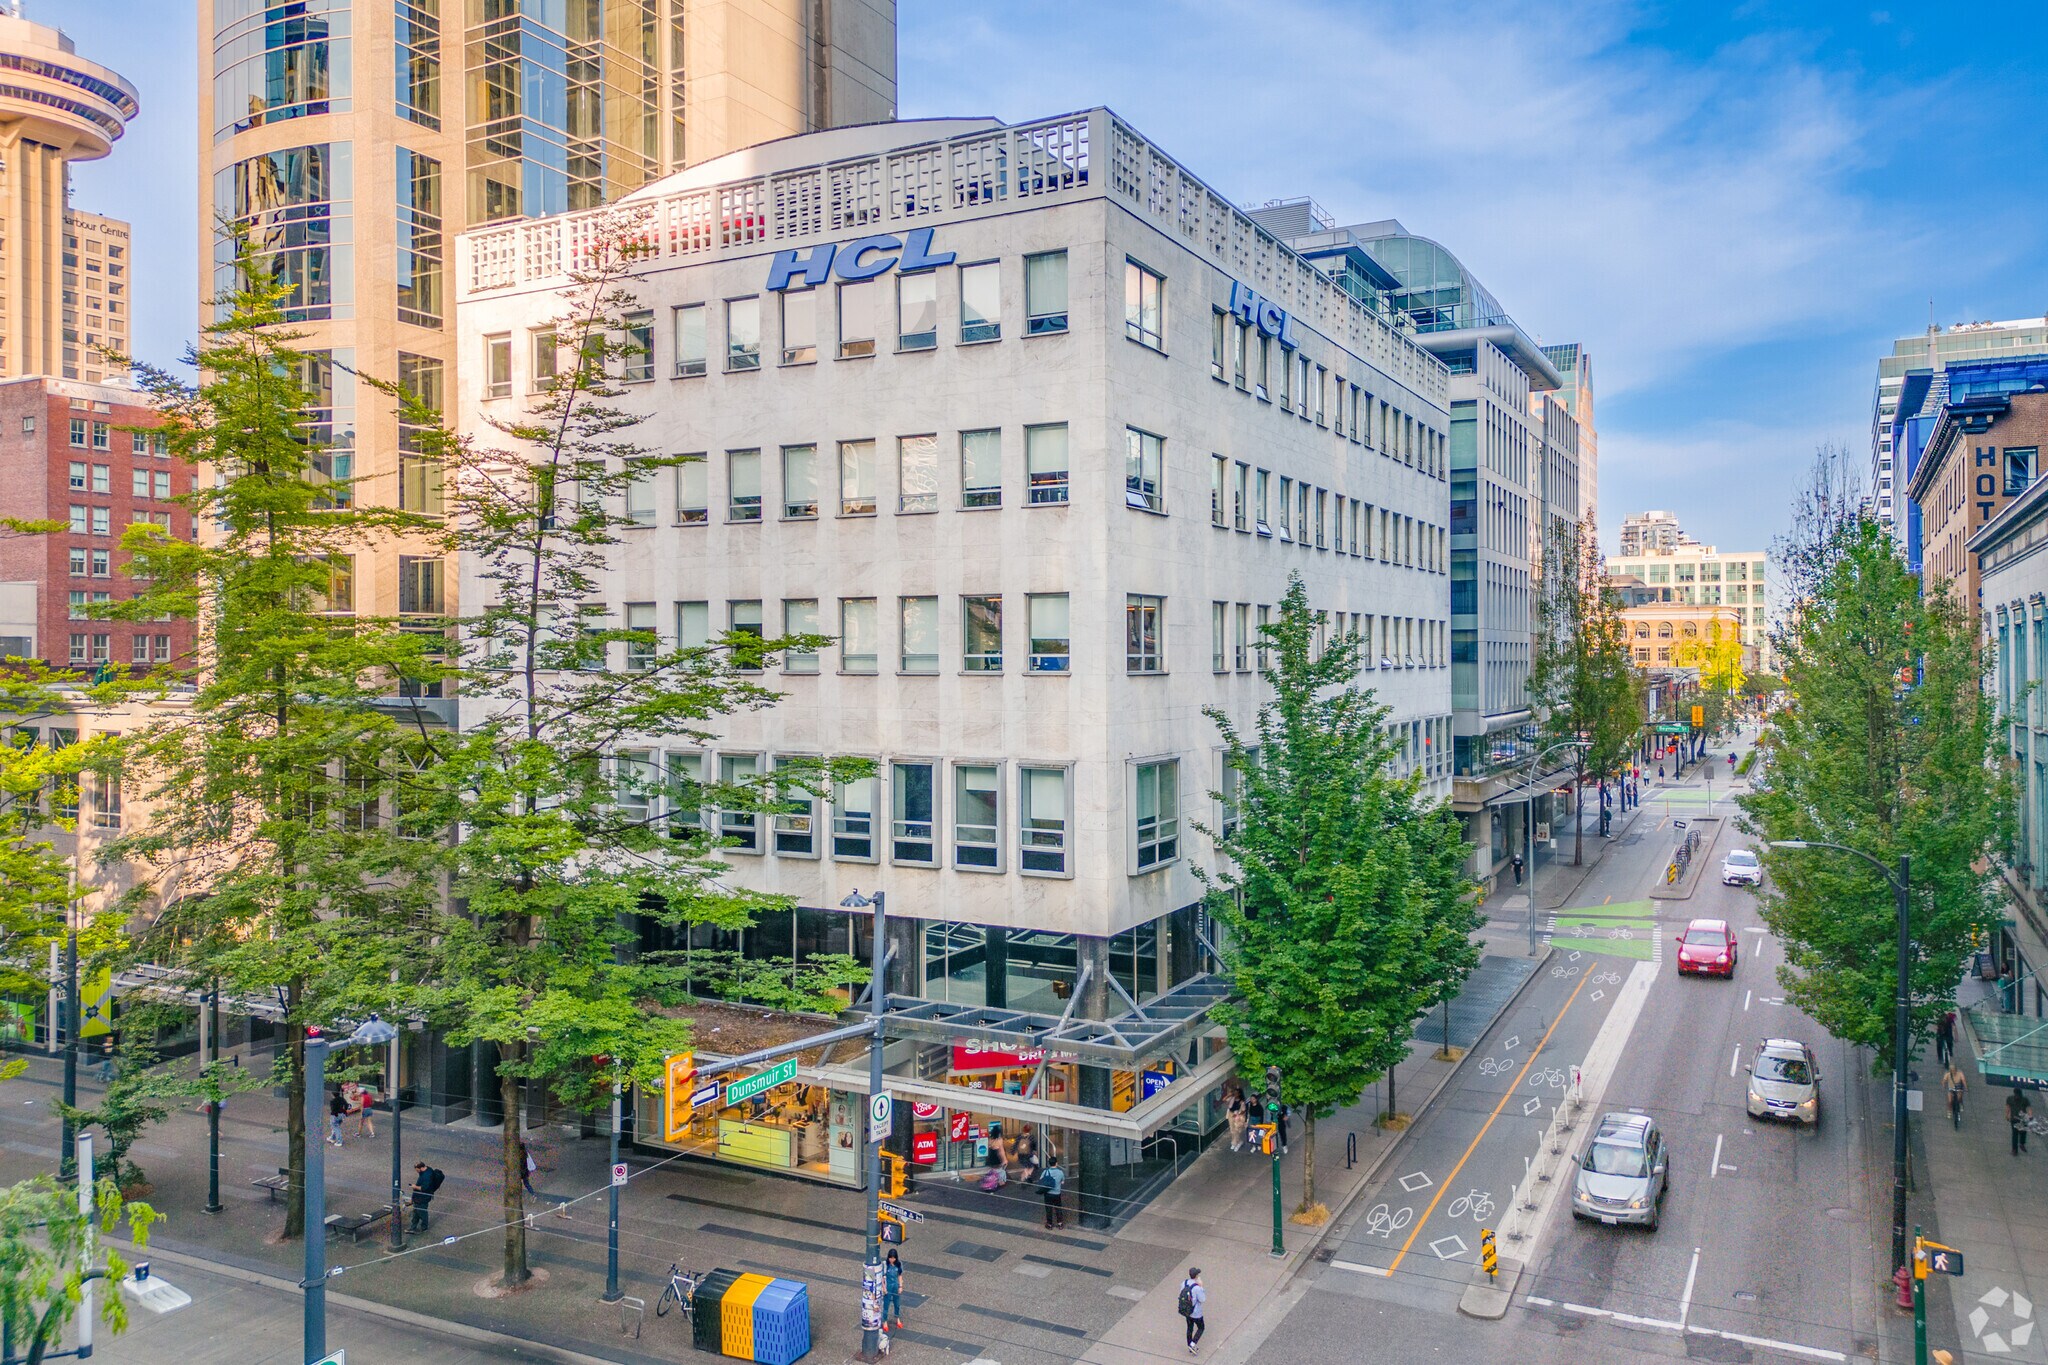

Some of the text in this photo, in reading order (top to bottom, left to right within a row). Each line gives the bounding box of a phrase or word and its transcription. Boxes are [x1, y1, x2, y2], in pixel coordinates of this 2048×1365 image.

[100, 224, 129, 239] Centre
[766, 228, 957, 291] HCL
[1229, 280, 1299, 348] HCL
[731, 1063, 793, 1100] Dunsmuir St
[969, 1081, 982, 1089] 586
[1145, 1077, 1164, 1086] OPEN
[873, 1121, 889, 1130] EXCEPT
[917, 1140, 934, 1148] ATM
[883, 1203, 907, 1217] Granville
